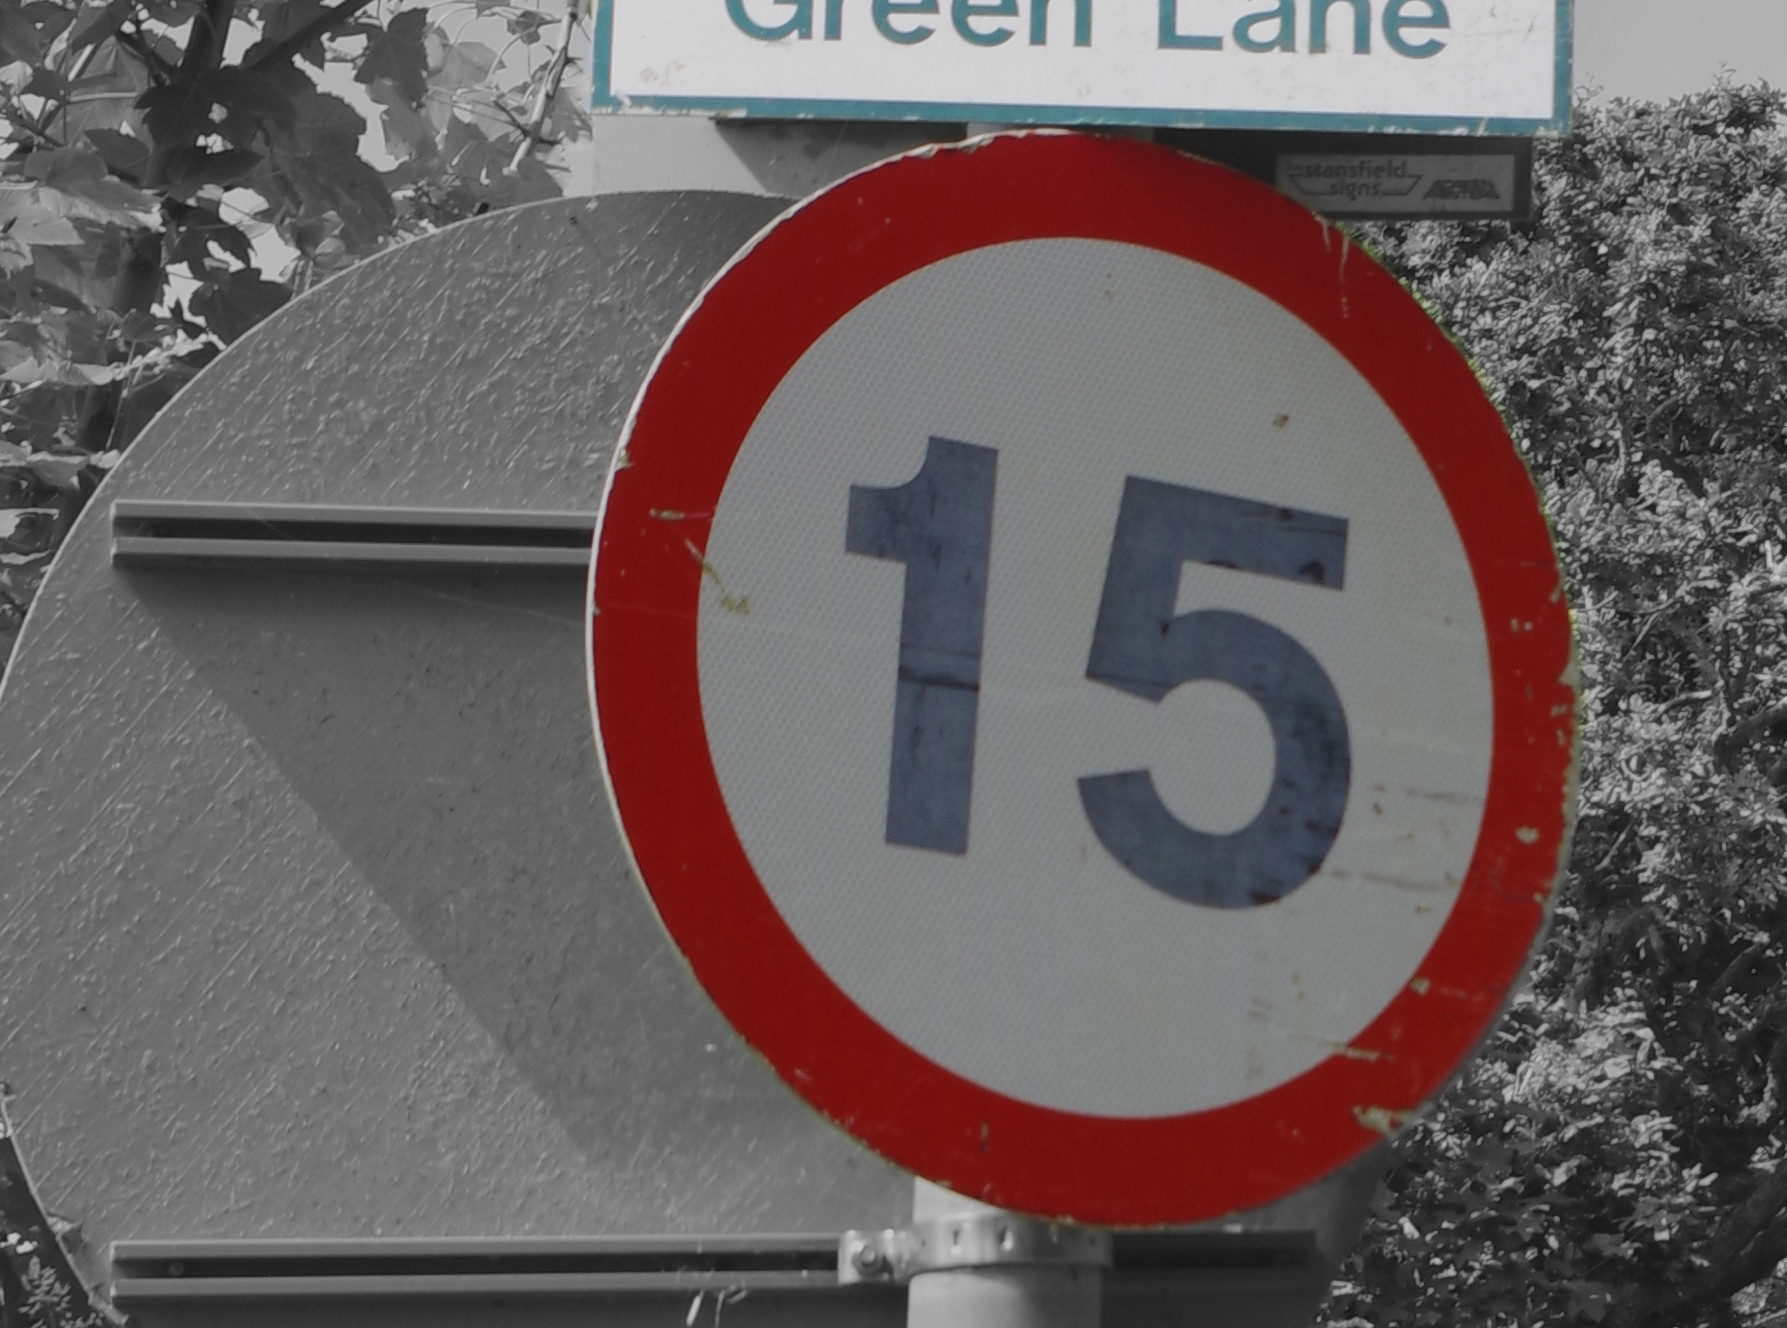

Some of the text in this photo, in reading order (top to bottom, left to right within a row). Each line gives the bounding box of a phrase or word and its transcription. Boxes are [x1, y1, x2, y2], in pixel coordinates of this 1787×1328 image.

[1304, 159, 1407, 178] stansfield
[1329, 178, 1382, 202] signs
[843, 435, 1351, 912] 15
